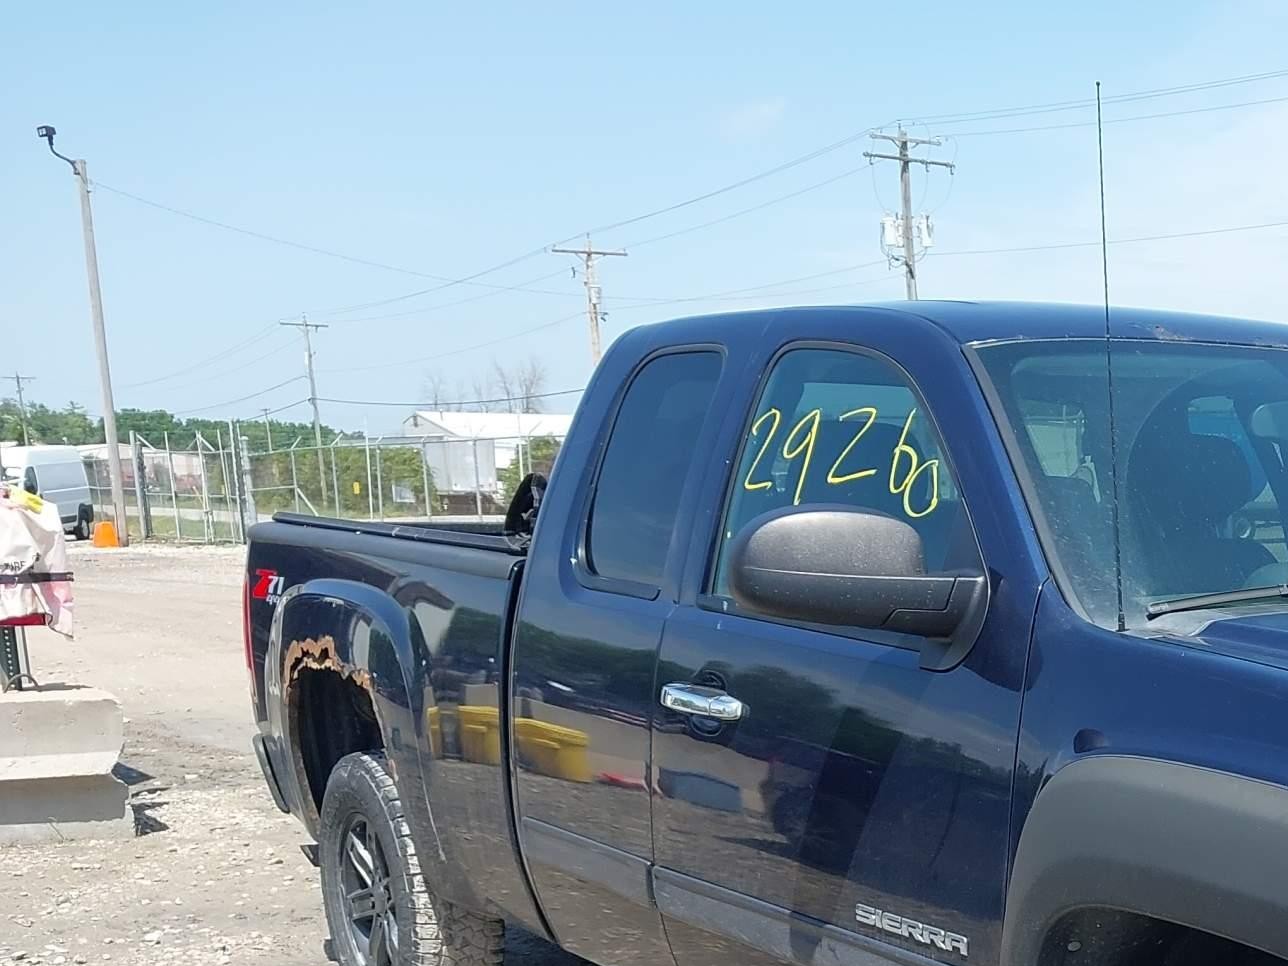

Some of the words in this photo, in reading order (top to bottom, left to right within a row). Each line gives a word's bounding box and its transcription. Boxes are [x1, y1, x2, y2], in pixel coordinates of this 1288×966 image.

[743, 407, 940, 519] 29260
[253, 569, 285, 598] Z71
[856, 903, 970, 957] SIERRA
